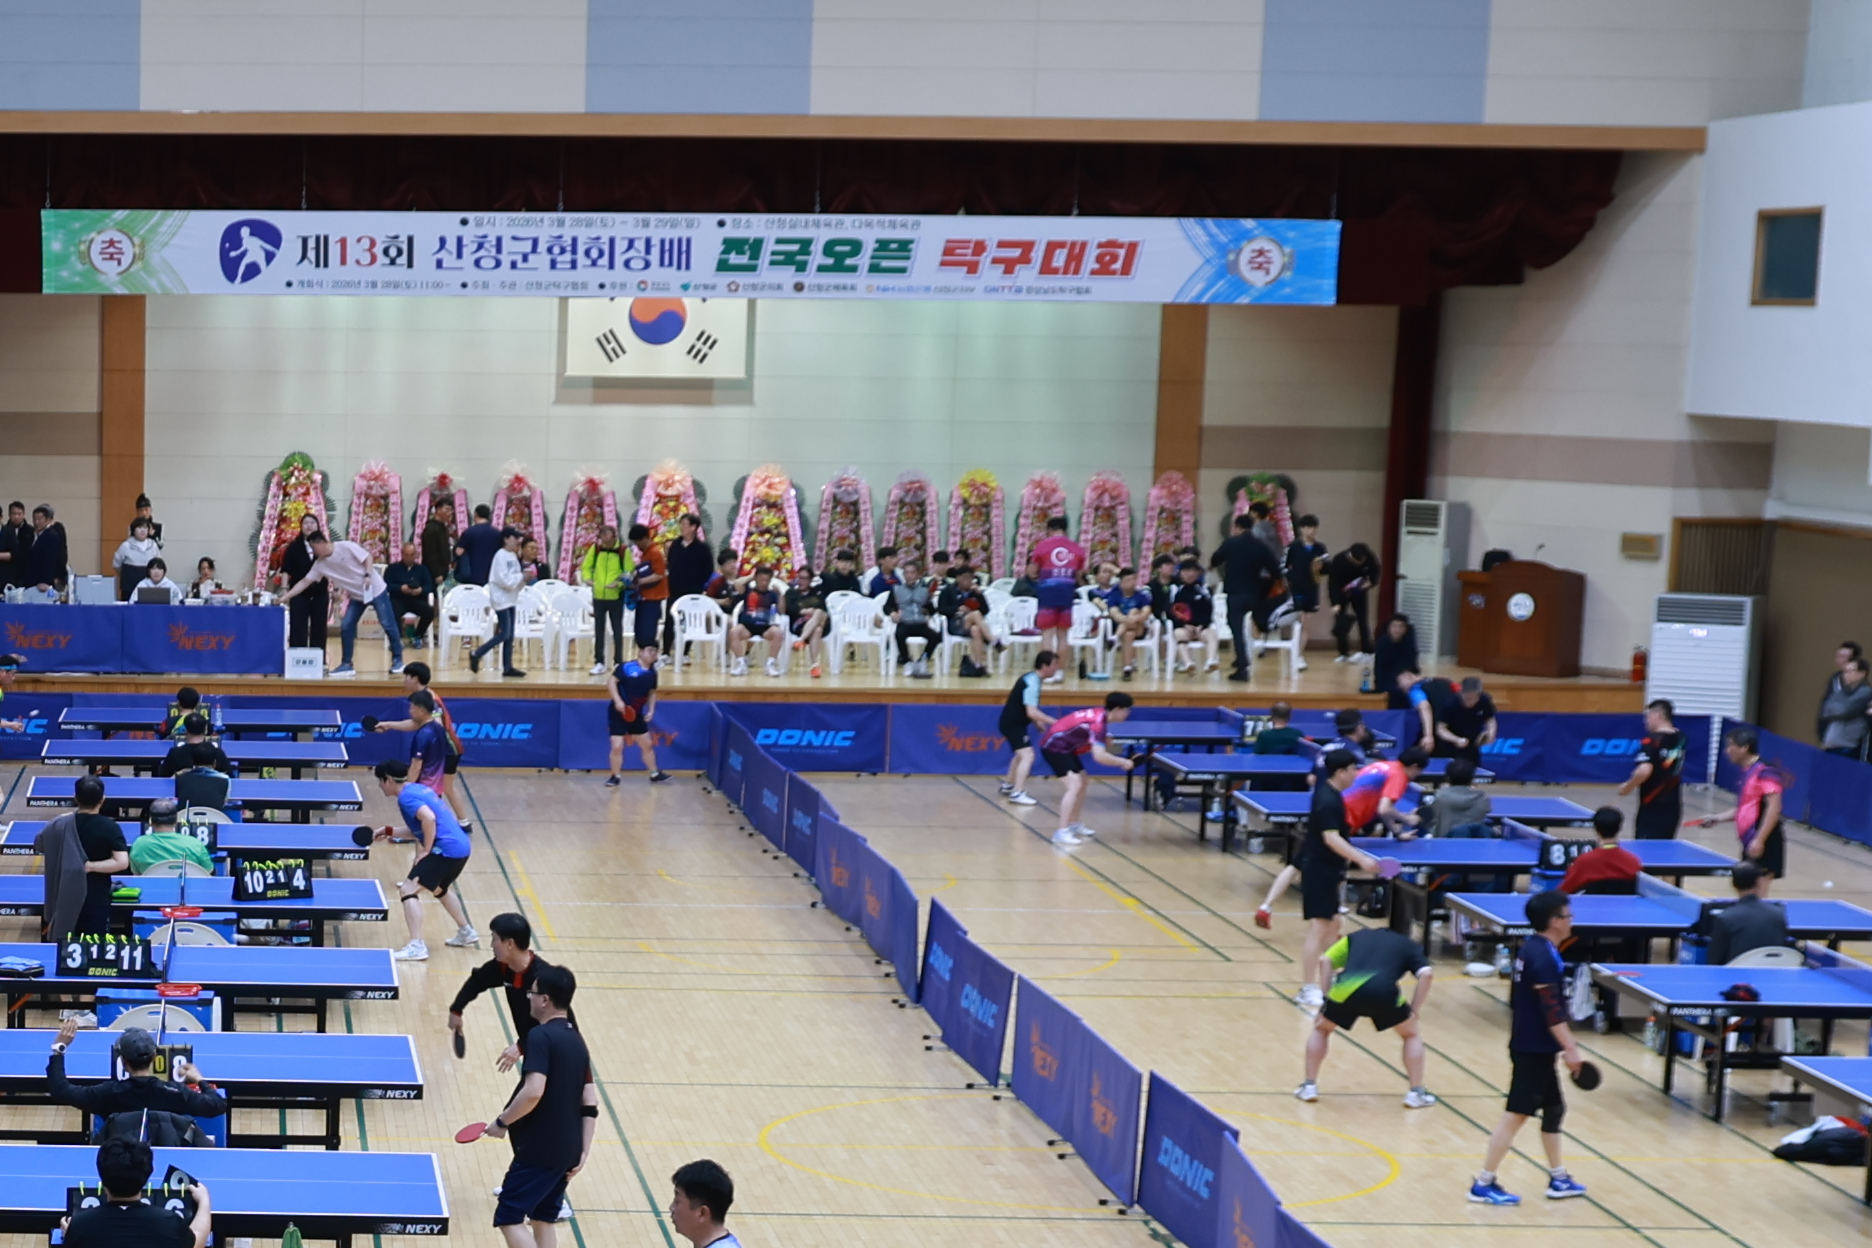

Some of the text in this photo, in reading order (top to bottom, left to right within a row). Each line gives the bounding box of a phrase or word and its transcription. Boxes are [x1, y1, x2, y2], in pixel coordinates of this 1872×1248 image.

[99, 235, 126, 270] 축
[296, 233, 1142, 276] 제13회 산청군협회장배 전국오픈 탁구대회
[1247, 238, 1274, 273] 축
[454, 722, 533, 740] ONIC
[755, 728, 857, 748] DONIC
[196, 825, 210, 847] 8
[2, 847, 35, 855] PANTHERA
[343, 852, 366, 860] NEXY
[243, 870, 264, 894] 10
[265, 870, 275, 884] 2
[292, 868, 306, 891] 4
[266, 889, 290, 898] DONIC
[358, 913, 385, 921] NEXY
[66, 943, 143, 971] 3 1 2 11
[87, 967, 120, 977] DONIC
[366, 990, 395, 999] NEXY
[386, 1089, 418, 1099] NEXY
[1157, 1135, 1215, 1200] DONIC
[405, 1223, 443, 1234] NEXY
